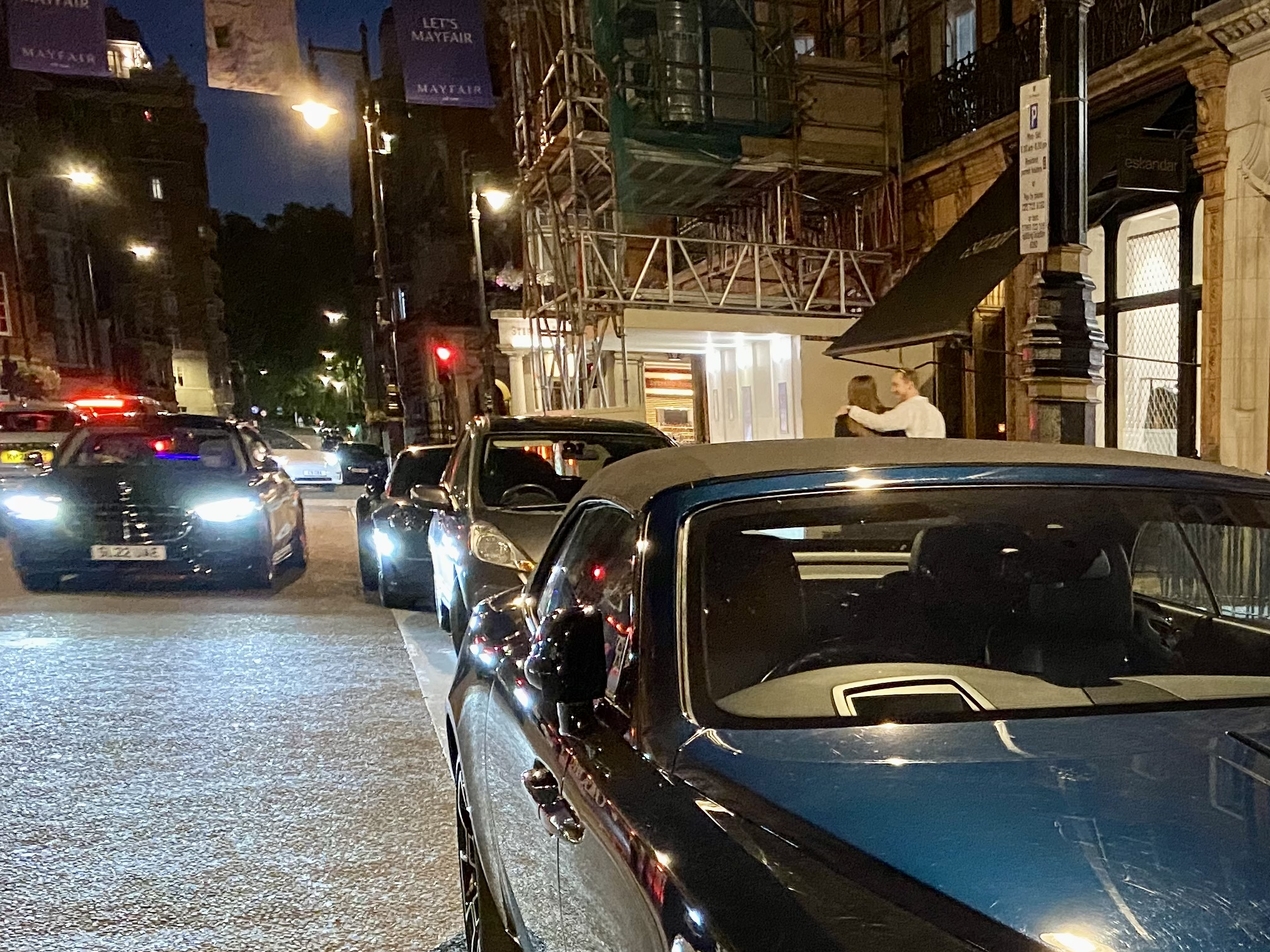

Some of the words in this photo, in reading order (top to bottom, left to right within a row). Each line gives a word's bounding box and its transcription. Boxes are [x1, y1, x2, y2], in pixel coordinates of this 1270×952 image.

[422, 17, 458, 30] LET'S
[411, 30, 473, 44] MAYFAIR
[21, 47, 96, 64] MAYFAIR
[417, 84, 482, 95] MAYFAIR
[1124, 156, 1178, 172] eskandar
